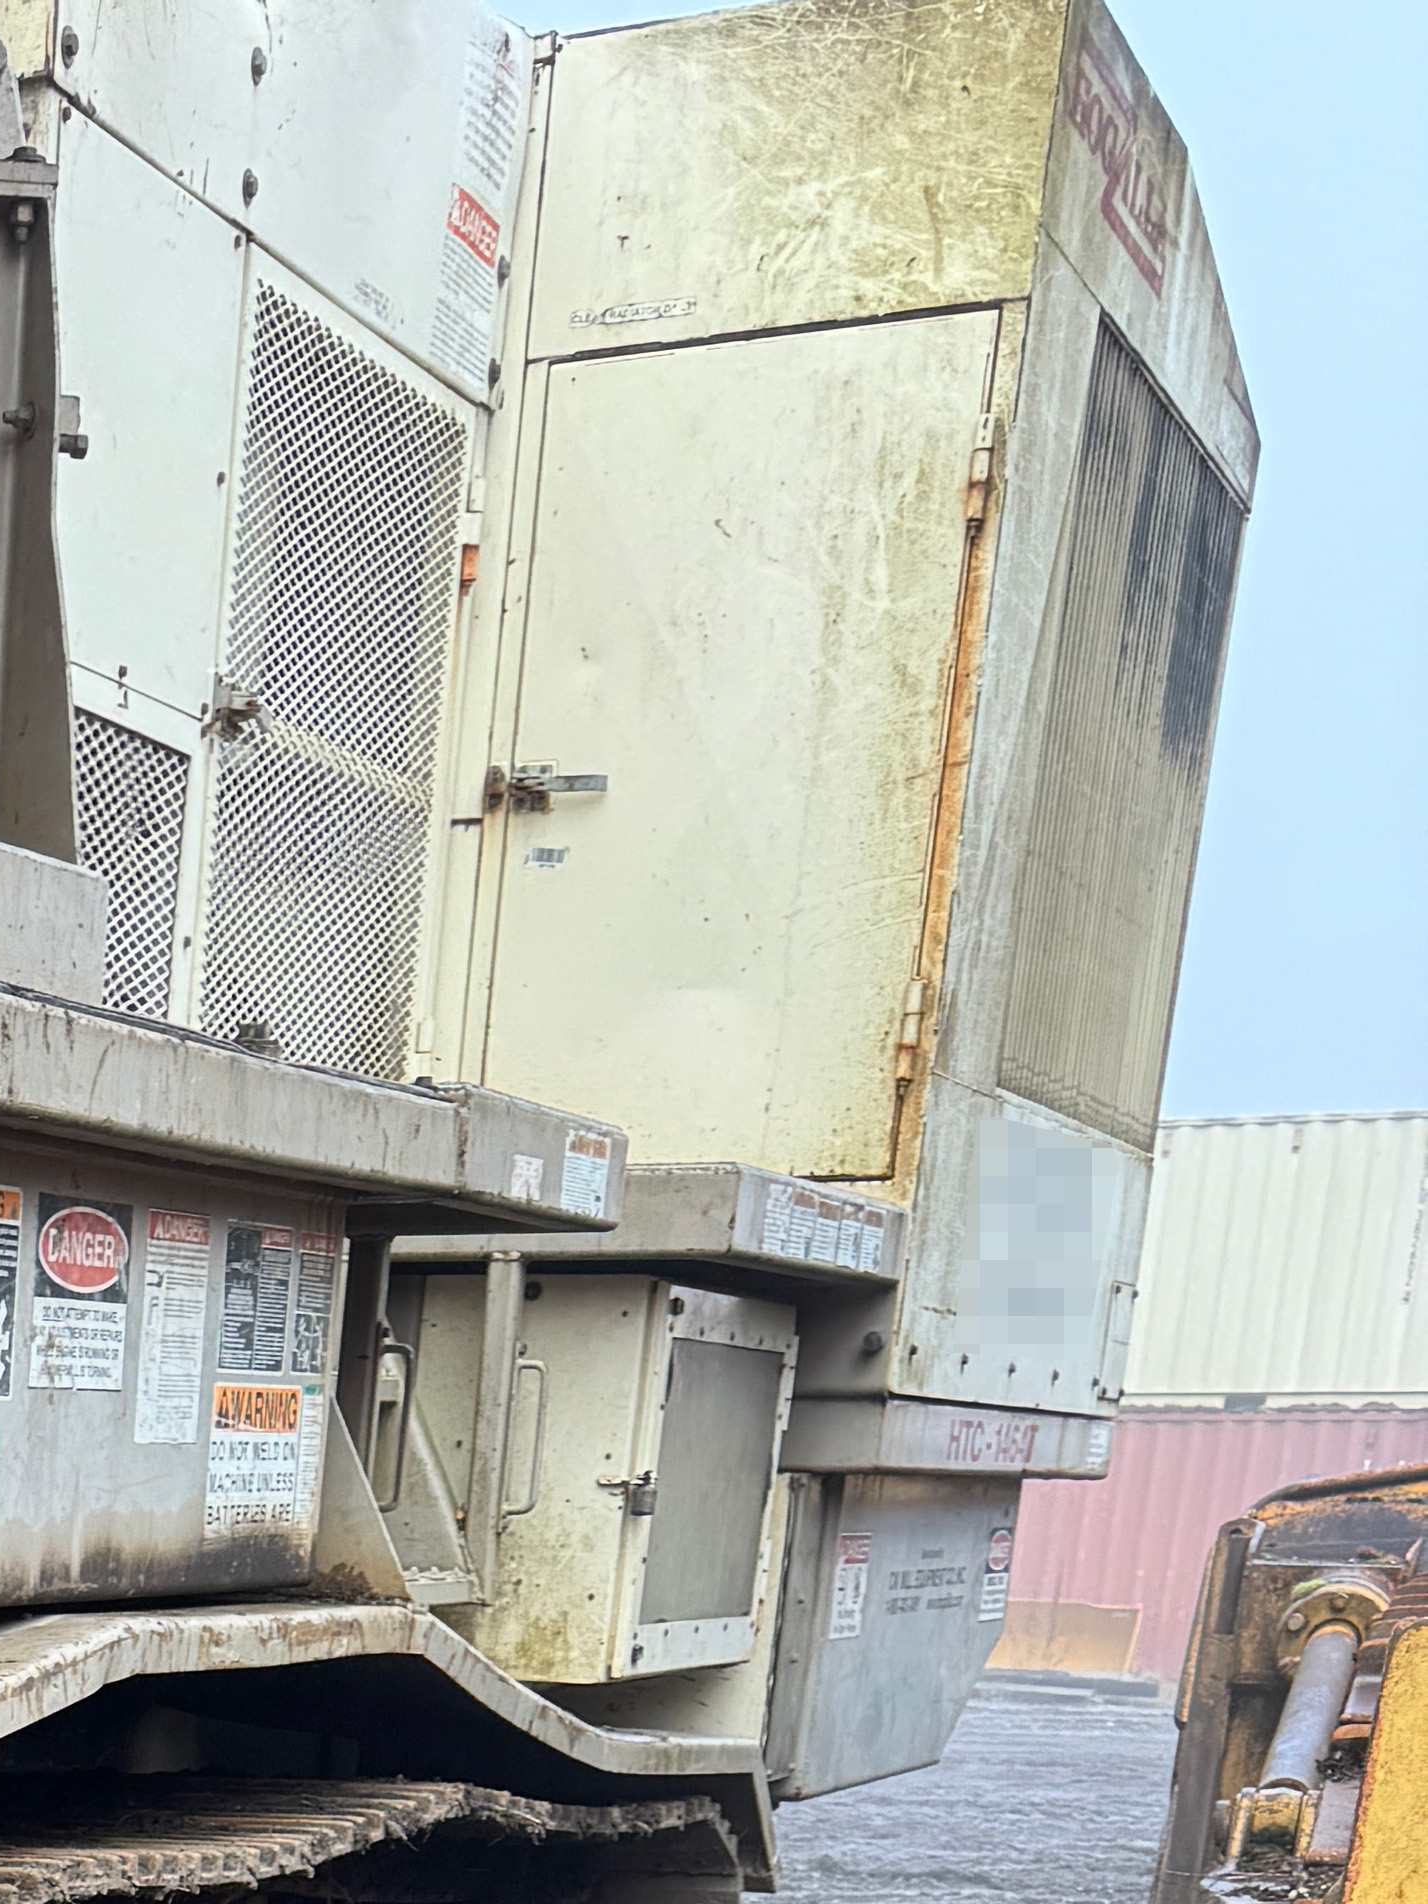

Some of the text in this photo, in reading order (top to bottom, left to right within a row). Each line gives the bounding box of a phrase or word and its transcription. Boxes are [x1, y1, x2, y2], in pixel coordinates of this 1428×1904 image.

[164, 1215, 206, 1244] DANGER
[48, 1228, 116, 1268] DANGER
[230, 1390, 298, 1430] WARNING
[211, 1441, 225, 1461] DO
[229, 1441, 250, 1461] NOT
[283, 1441, 296, 1461] ON
[209, 1473, 294, 1493] MACHINE UNLESS
[271, 1503, 292, 1523] ARE
